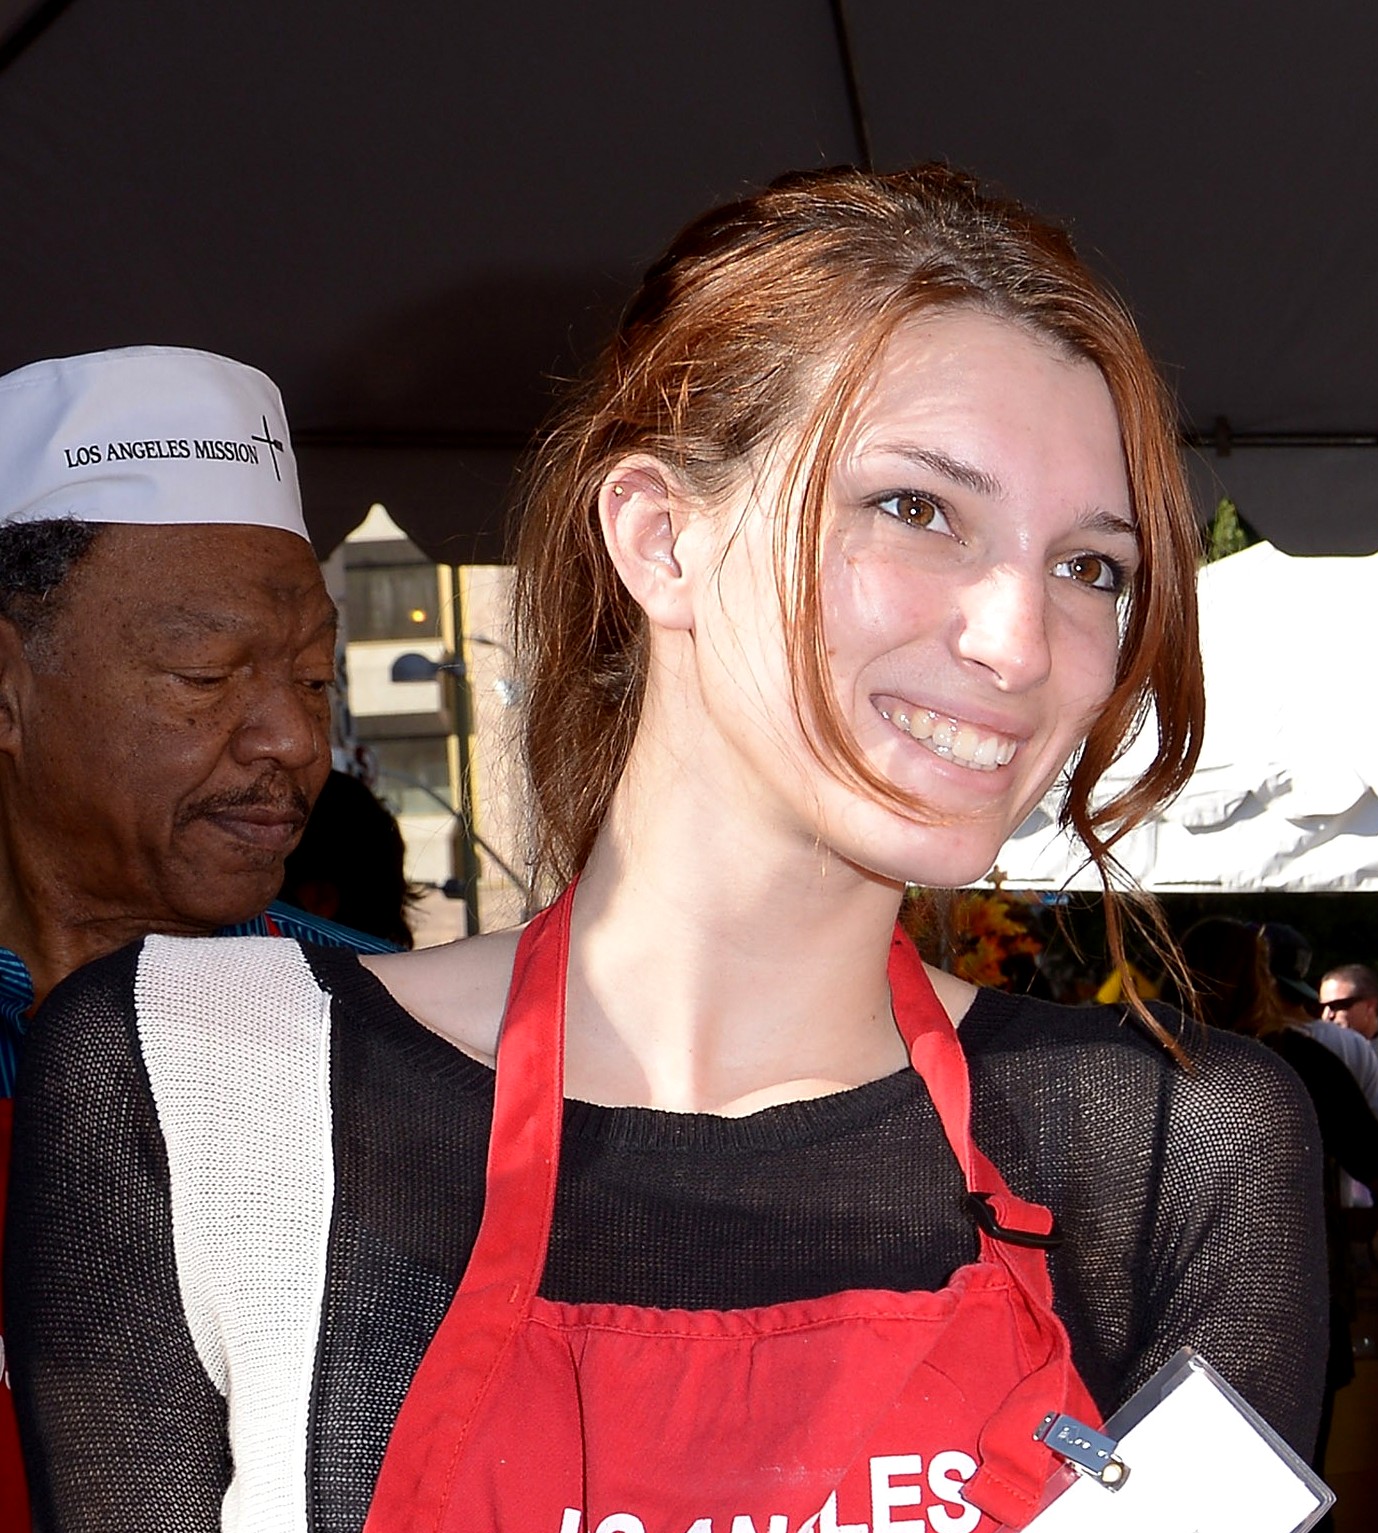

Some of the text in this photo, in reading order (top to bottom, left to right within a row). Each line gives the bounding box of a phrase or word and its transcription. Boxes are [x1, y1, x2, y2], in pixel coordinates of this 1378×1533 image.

[64, 439, 259, 468] LOS ANGELES MISSION
